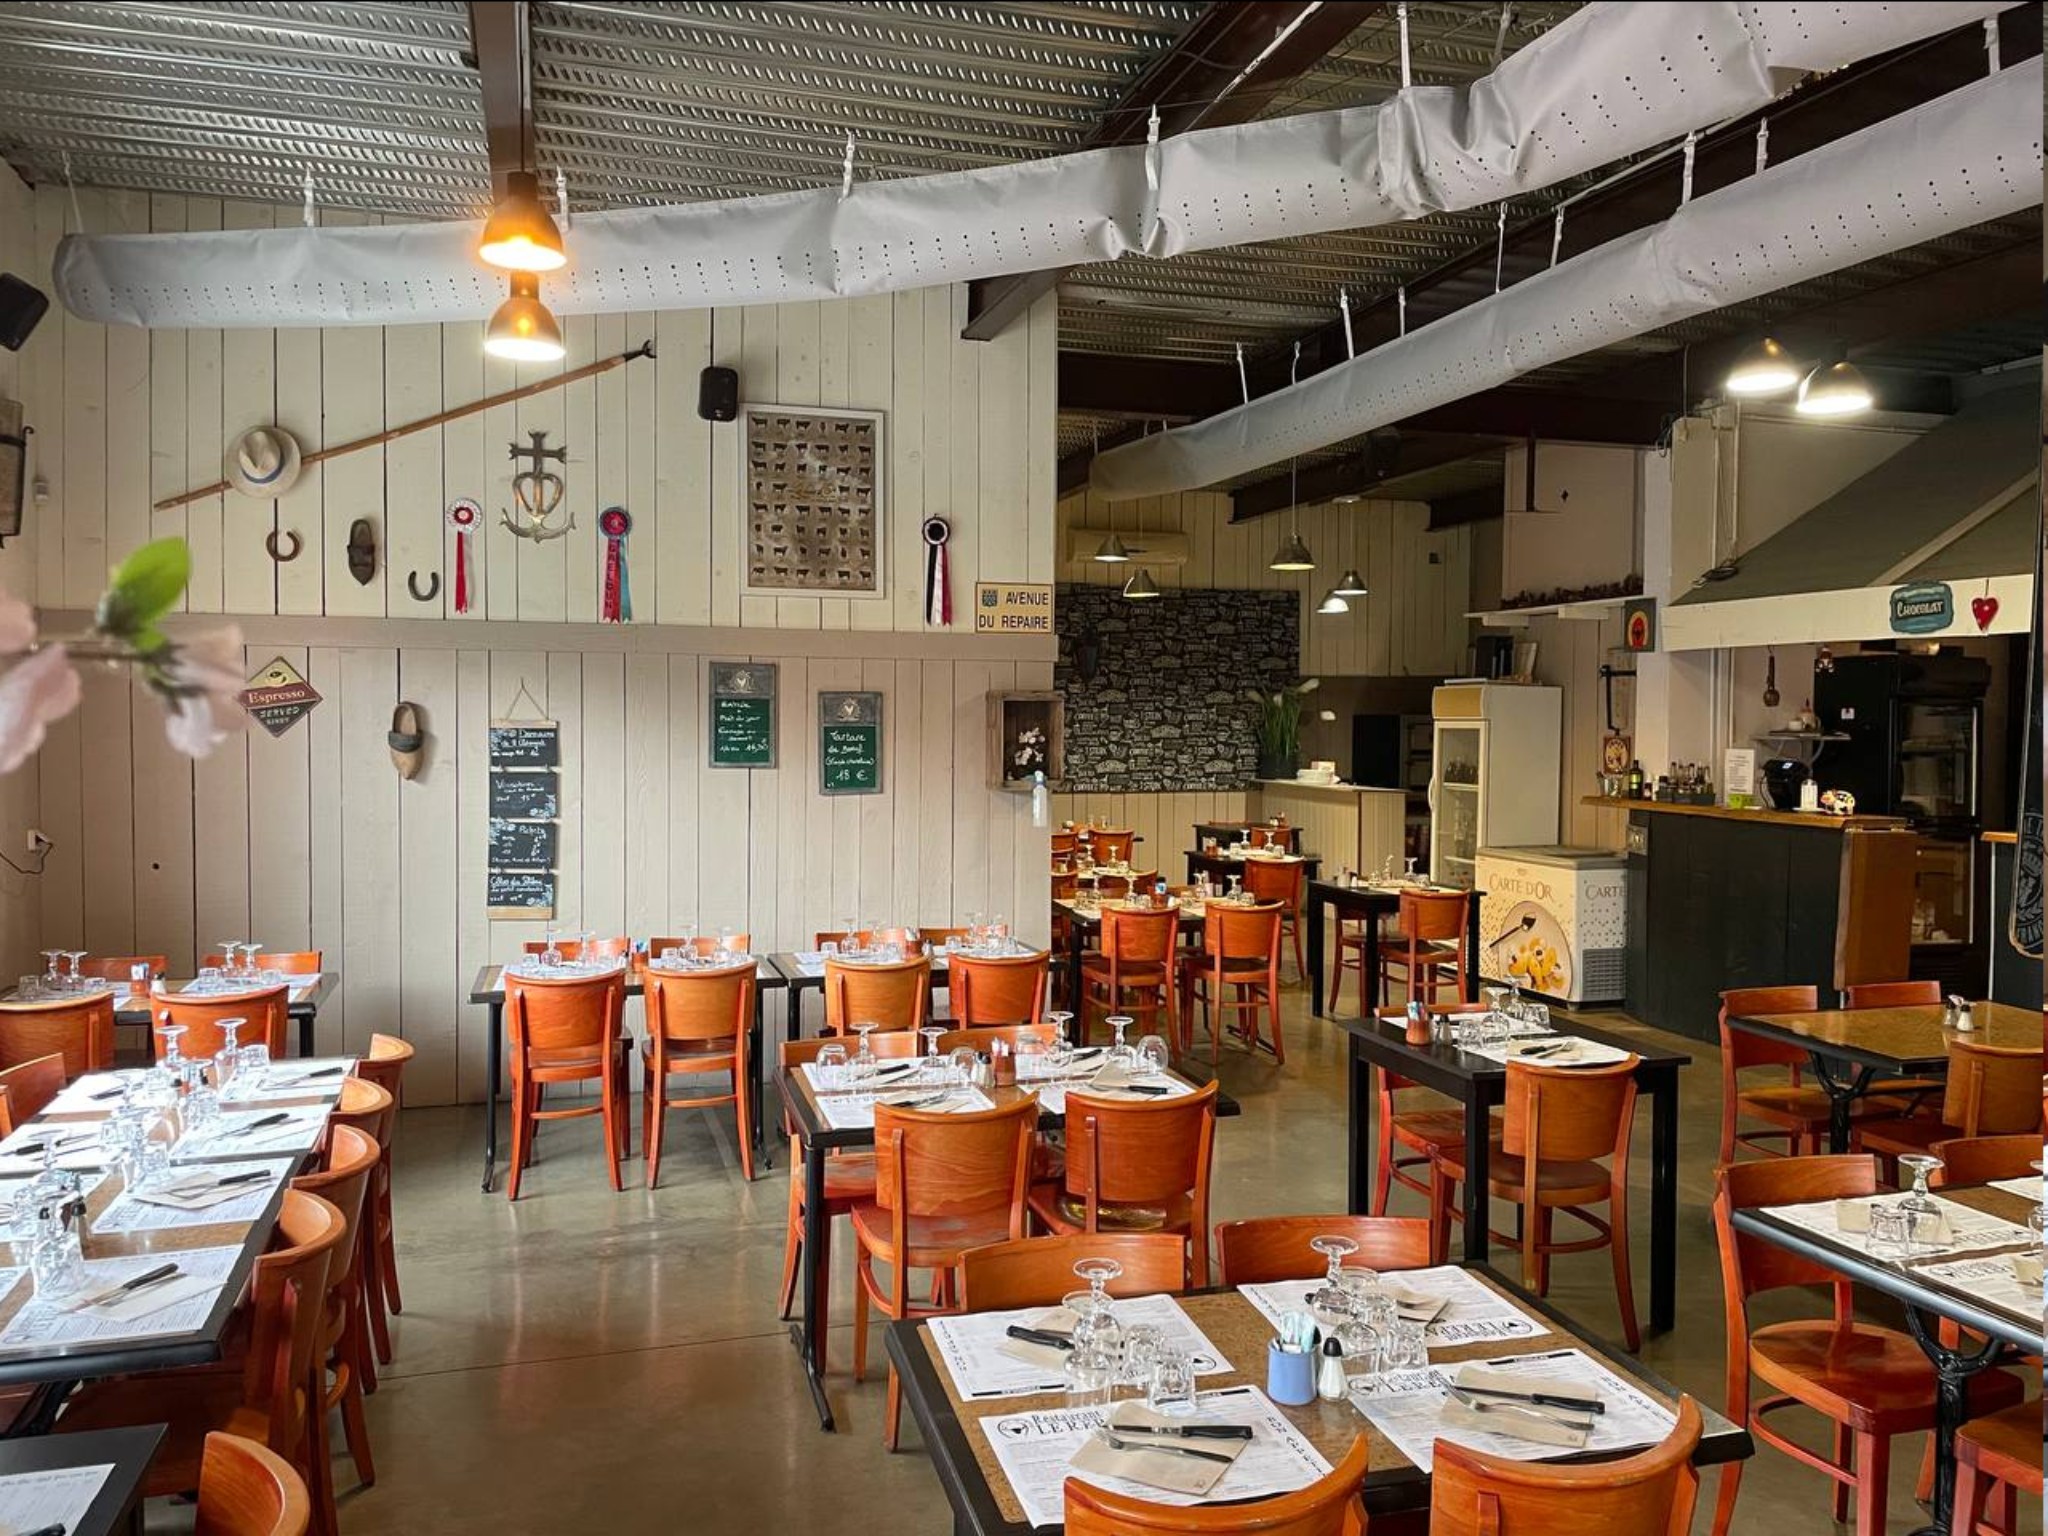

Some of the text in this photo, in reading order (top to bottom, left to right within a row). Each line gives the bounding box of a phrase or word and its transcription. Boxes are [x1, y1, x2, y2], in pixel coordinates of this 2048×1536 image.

[1006, 591, 1049, 606] AVENUE
[979, 614, 1049, 630] DU REPAIRE
[248, 690, 305, 704] Espresso
[830, 730, 866, 742] Tartare
[1488, 873, 1523, 895] CARTE
[1031, 1410, 1102, 1426] Restaurant
